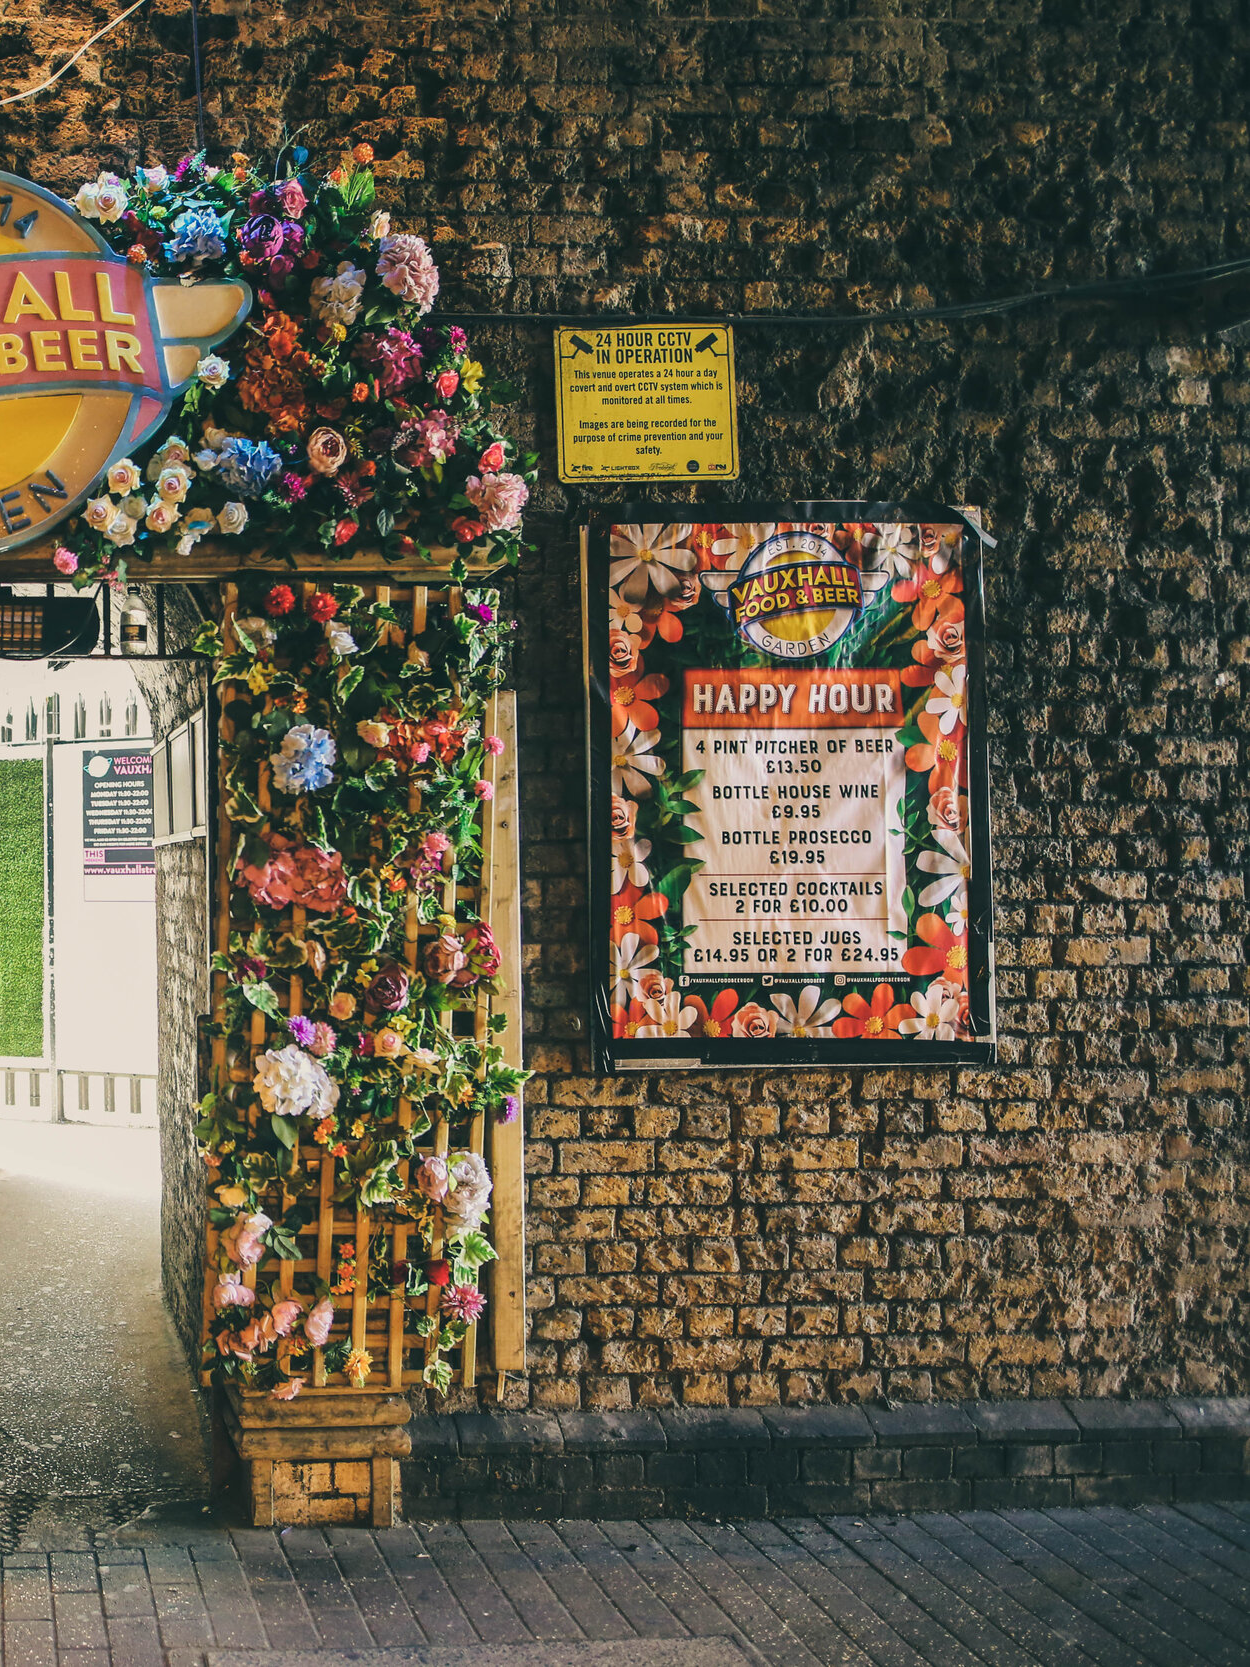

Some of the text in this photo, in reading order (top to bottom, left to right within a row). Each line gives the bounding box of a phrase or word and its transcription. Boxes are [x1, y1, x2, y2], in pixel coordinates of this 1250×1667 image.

[595, 332, 691, 347] 24 HOUR CCTV
[596, 348, 693, 364] IN OPERATION
[574, 370, 590, 379] This
[592, 371, 616, 379] venue
[618, 370, 654, 381] operates
[664, 369, 673, 378] 24
[676, 369, 693, 378] hour
[703, 368, 718, 379] day
[570, 381, 723, 393] covert and overt CCTV system which is
[602, 395, 692, 405] monitored at all times.
[579, 418, 716, 430] Images are being recorded for the
[573, 432, 723, 444] purpose of crime prevention and your
[636, 446, 662, 456] safety.
[767, 538, 827, 558] EST. 2014
[731, 566, 854, 604] VAUXHALL
[734, 588, 860, 624] FOOD & BEER
[762, 632, 830, 656] GARDEN
[693, 683, 894, 714] HAPPY HOUR
[696, 739, 894, 754] 4 PINT PITCHER OF BEER
[766, 759, 822, 774] £13.50
[94, 780, 144, 789] OPENING HOURS
[712, 784, 879, 800] BOTTLE HOUSE WINE
[772, 804, 820, 818] £9.95
[722, 830, 872, 844] BOTTLE PROSECCO
[85, 850, 104, 858] THIS
[770, 850, 825, 864] £19.95
[709, 882, 883, 896] SELECTED COCKTAILS
[736, 898, 848, 913] 2 FOR £10.00
[732, 930, 861, 945] SELECTED JUGS
[694, 948, 898, 962] £14.95 OR 2 FOR £24.95
